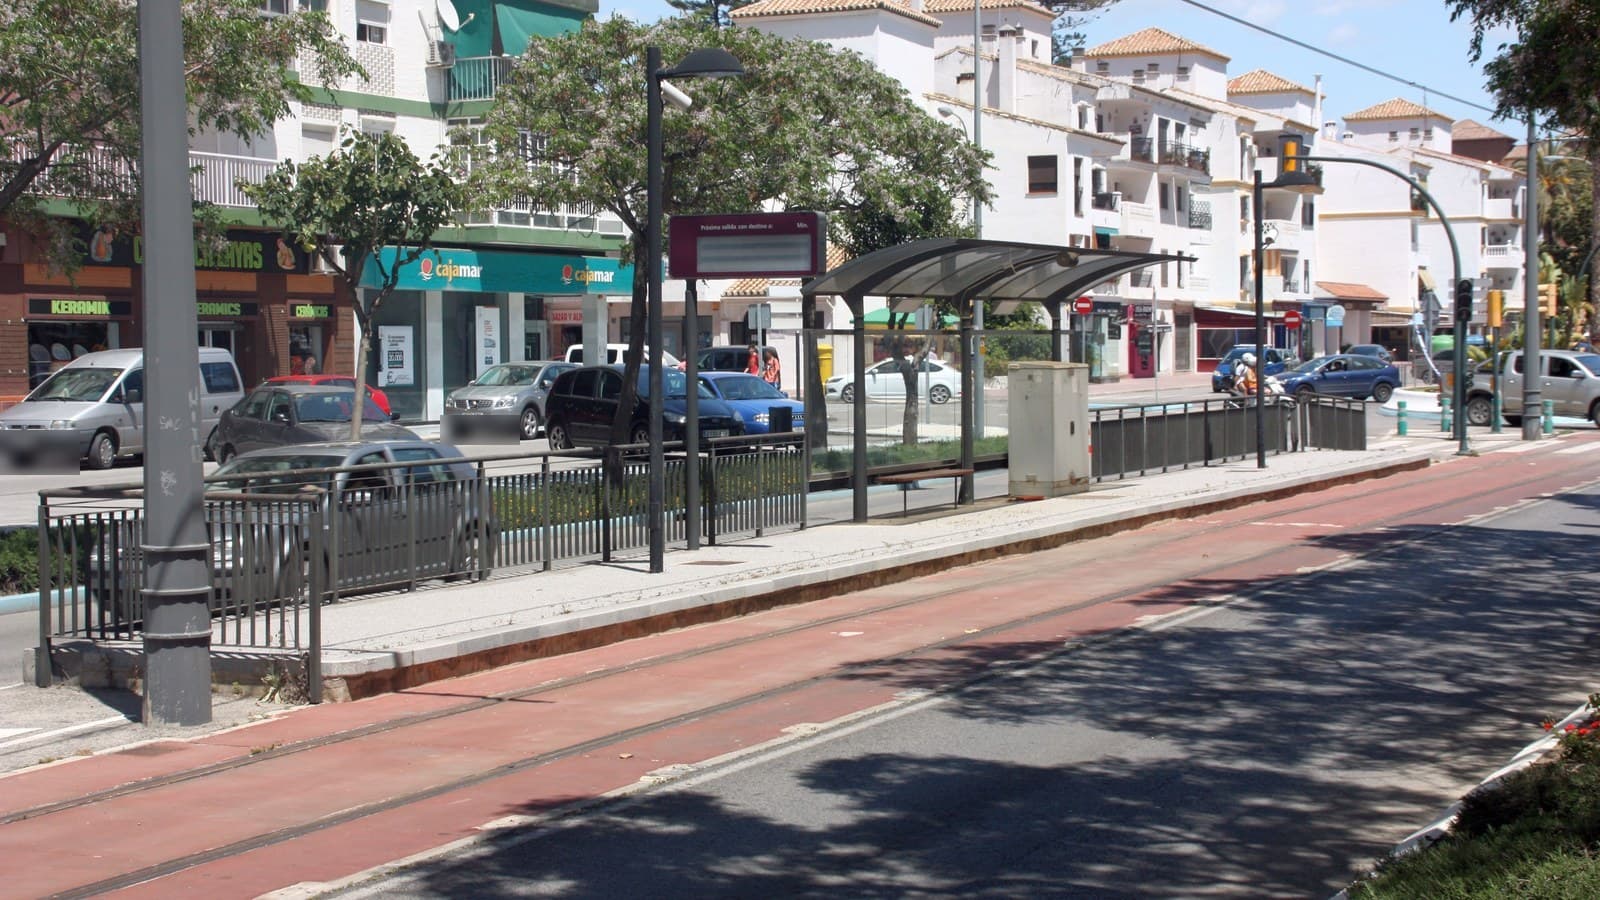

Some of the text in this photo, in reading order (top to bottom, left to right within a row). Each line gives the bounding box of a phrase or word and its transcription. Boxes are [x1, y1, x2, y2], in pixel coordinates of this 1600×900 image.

[436, 259, 482, 282] cajamar
[575, 266, 614, 286] cajamar
[51, 300, 111, 315] KERAMIK
[196, 302, 241, 316] ERAMICS
